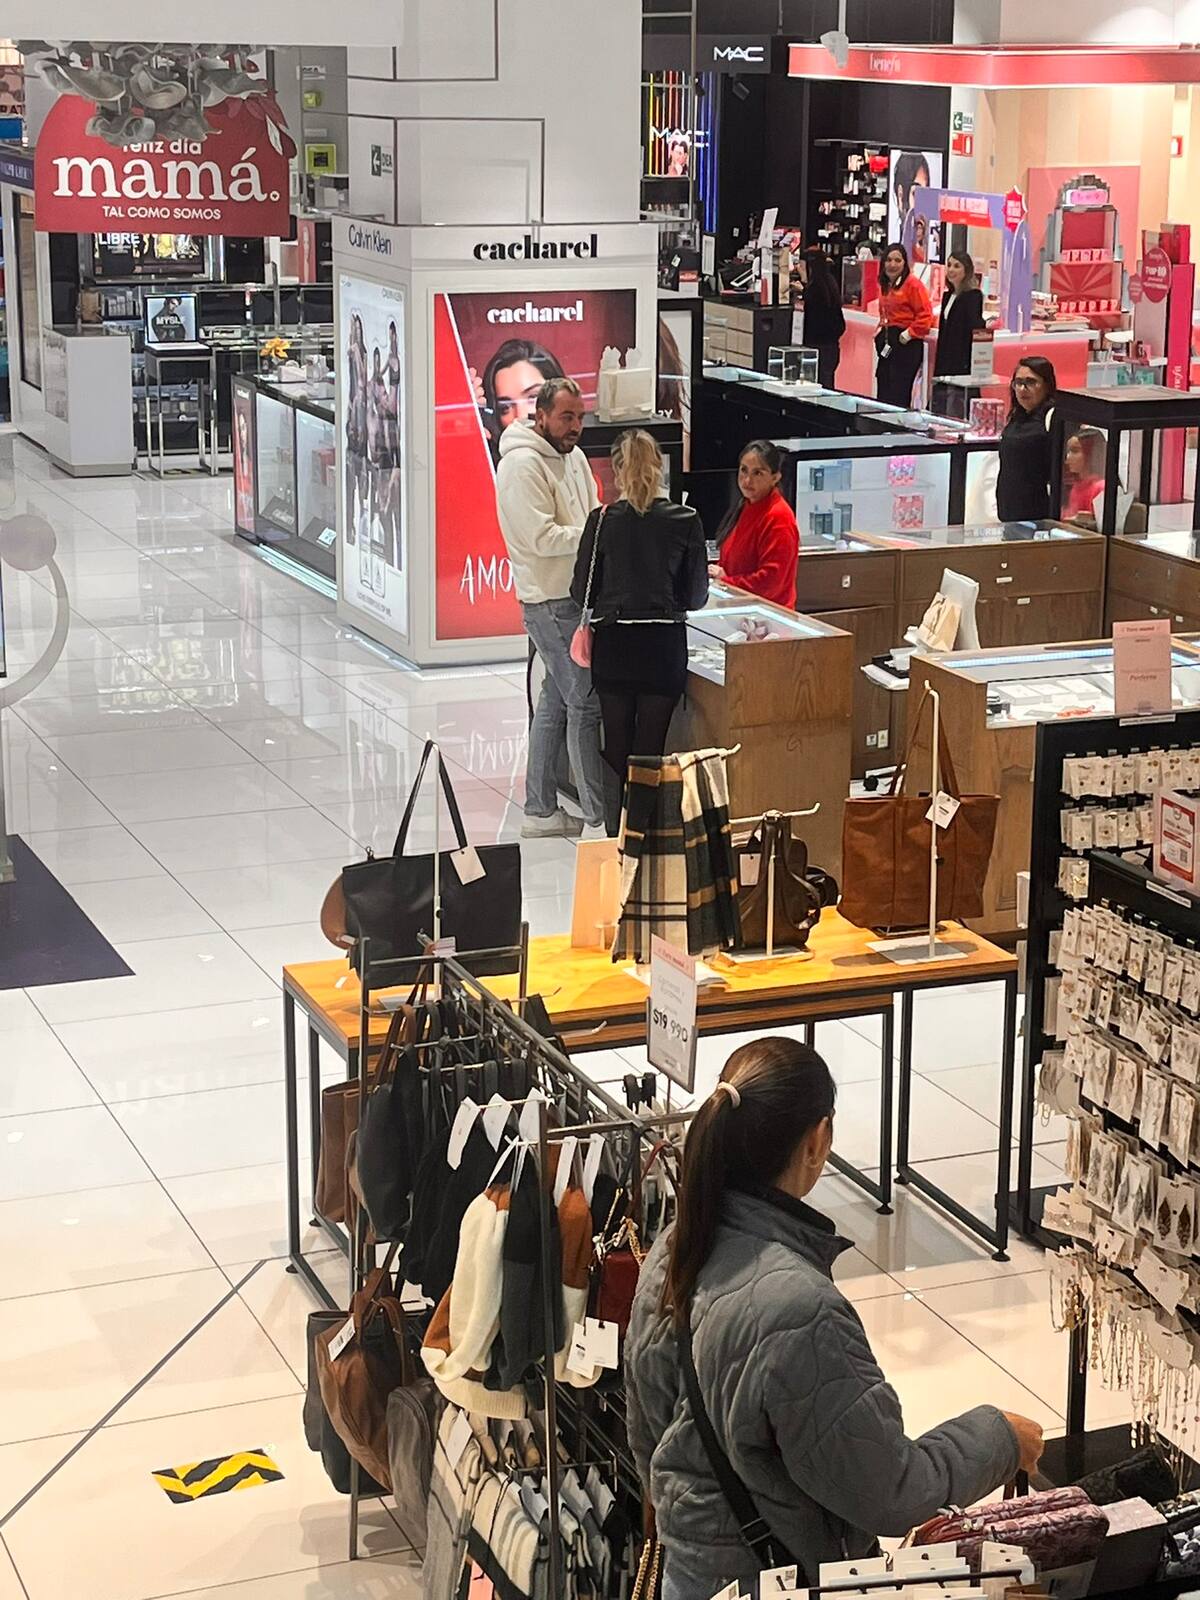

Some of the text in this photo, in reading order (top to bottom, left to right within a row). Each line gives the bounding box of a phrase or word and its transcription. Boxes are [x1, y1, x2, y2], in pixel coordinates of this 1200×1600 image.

[713, 46, 764, 62] MAC
[102, 205, 222, 220] TAL COMO SOMOS
[98, 232, 141, 245] LIBRE
[472, 233, 598, 261] cacharel
[486, 300, 584, 324] cacharel
